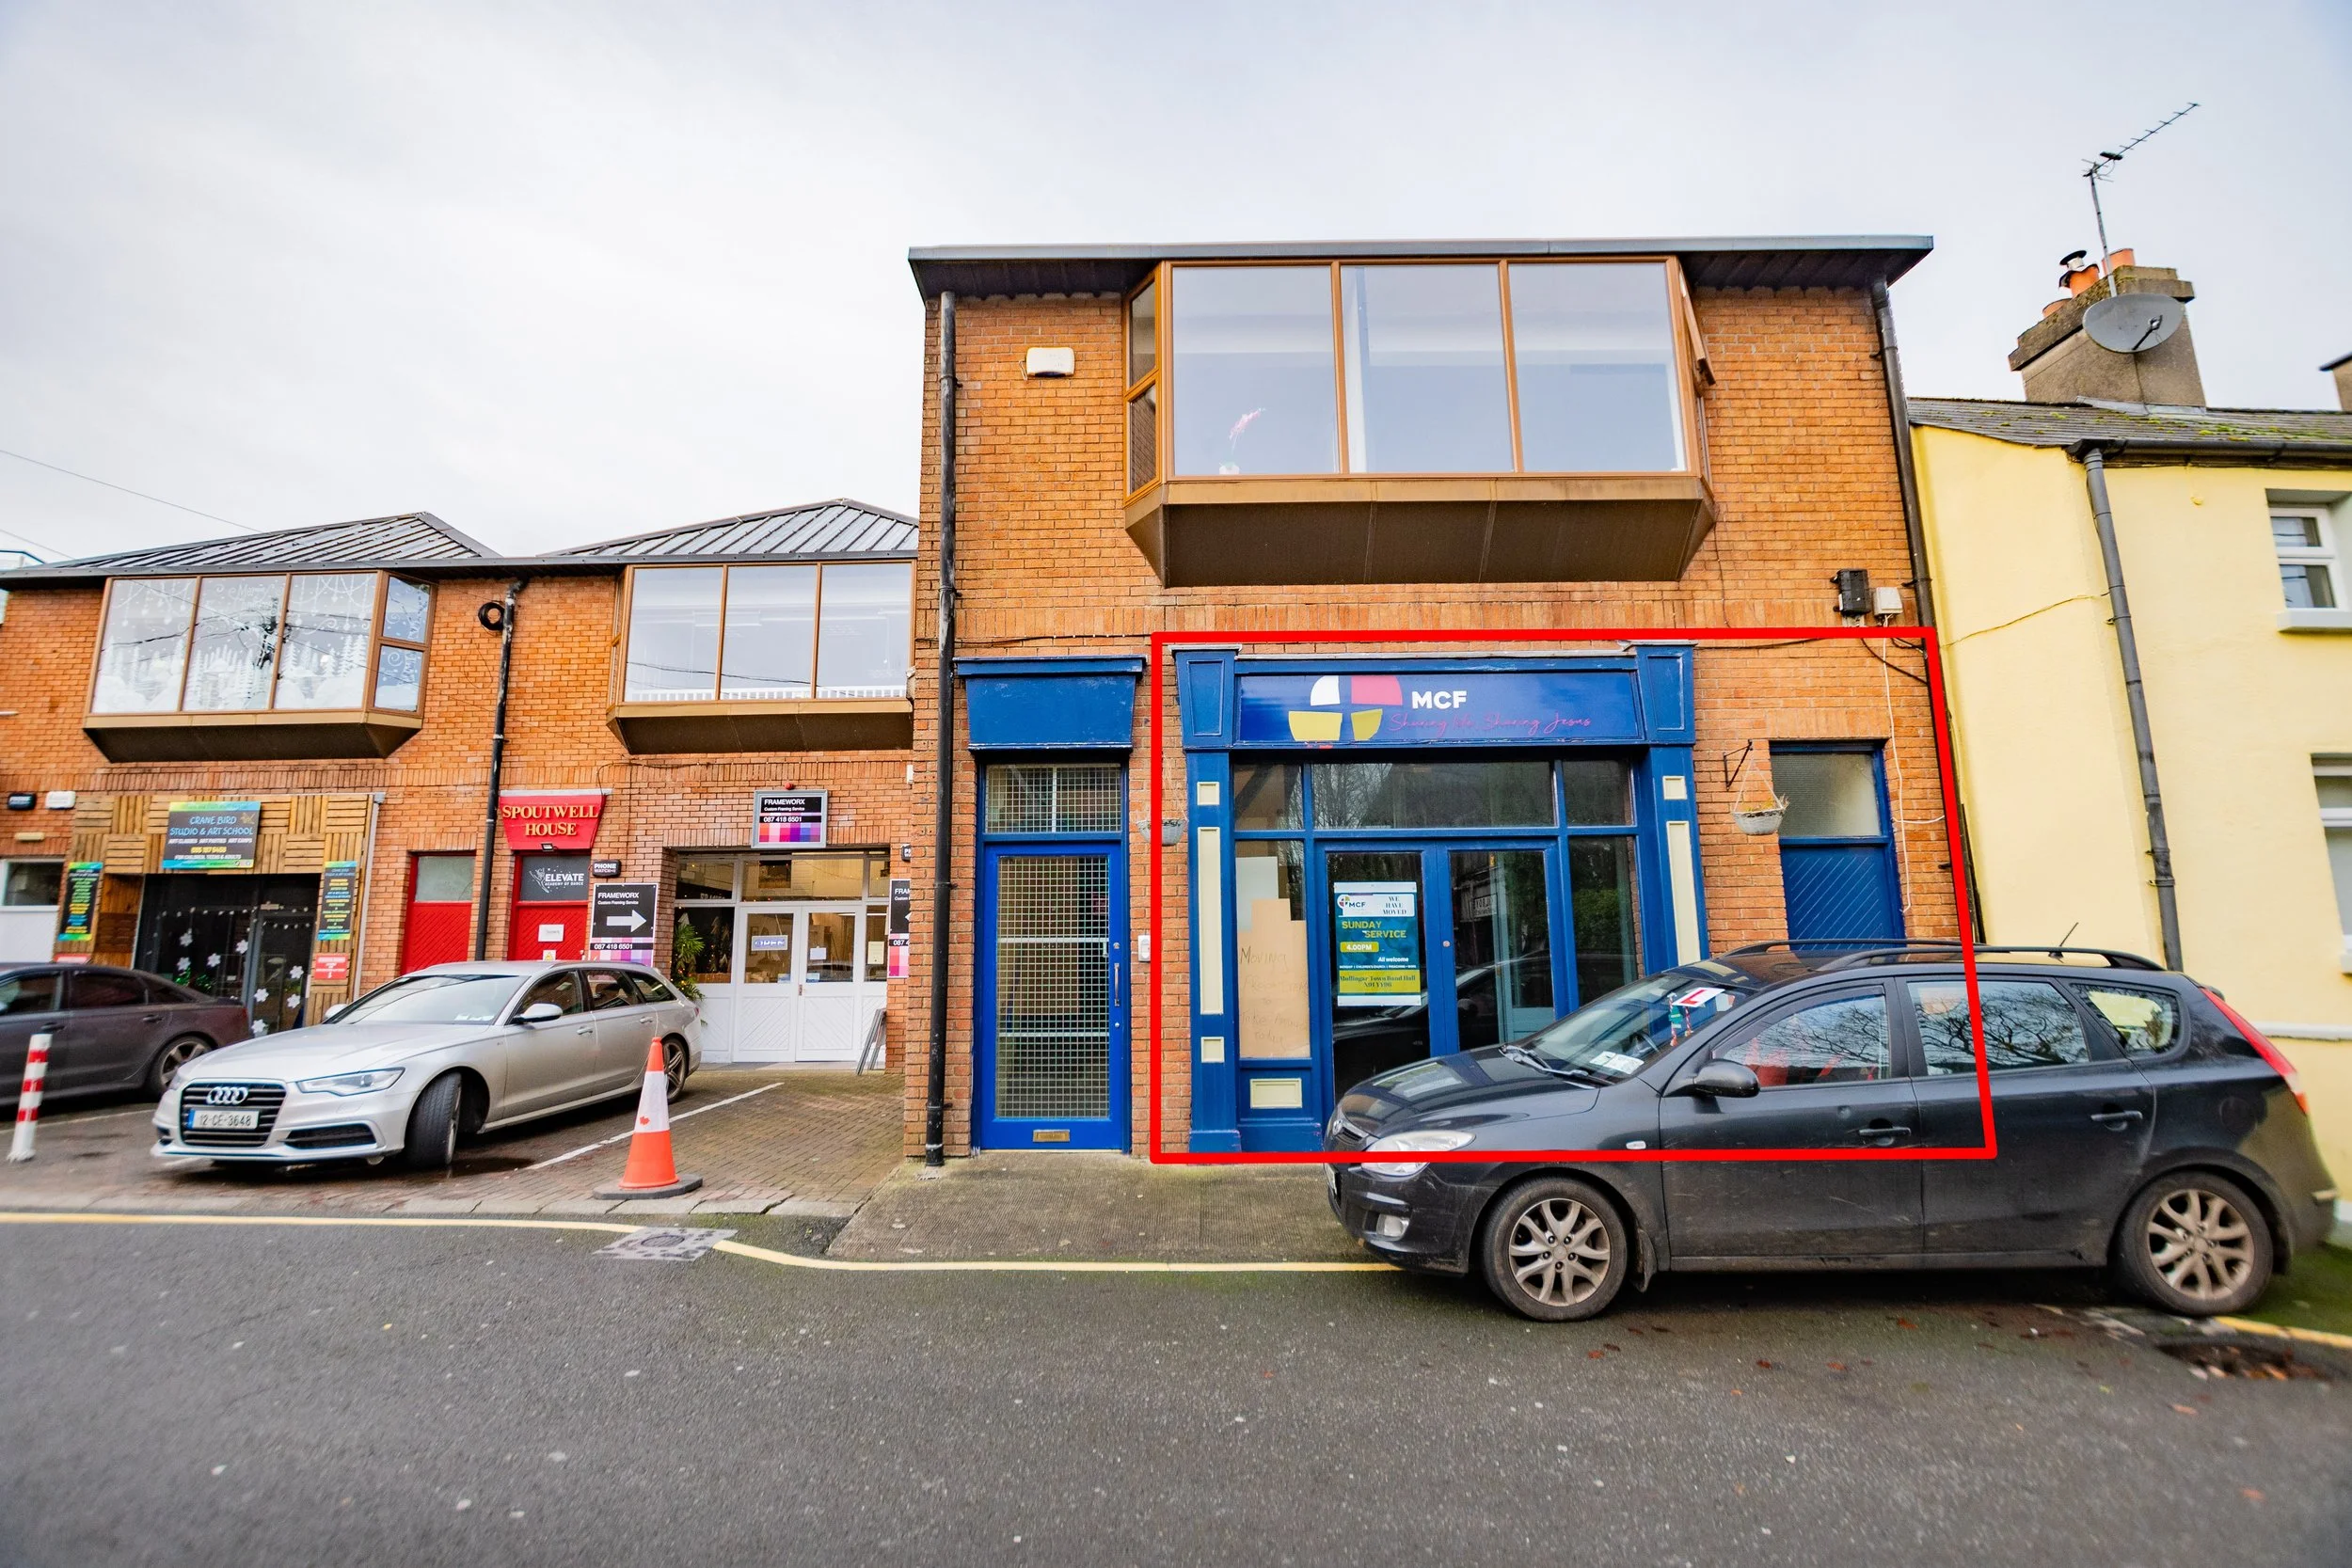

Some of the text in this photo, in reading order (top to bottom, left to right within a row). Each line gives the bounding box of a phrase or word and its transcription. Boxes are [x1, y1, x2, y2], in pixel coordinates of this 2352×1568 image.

[1411, 690, 1468, 709] MCF
[1388, 712, 1447, 737] Sharing
[1483, 711, 1541, 736] Sharing
[1543, 709, 1592, 735] Jesus
[501, 804, 599, 819] SPOUTWELL
[189, 816, 237, 825] CRANE BIRD
[170, 827, 254, 836] STUDIO & ART SCHOOL
[525, 822, 577, 836] HOUSE
[545, 873, 585, 882] ELEVATE
[1342, 921, 1382, 929] SUNDAY
[1364, 929, 1406, 939] SERVICE
[1679, 989, 1708, 1005] L
[199, 1113, 252, 1127] 12-CE-3648
